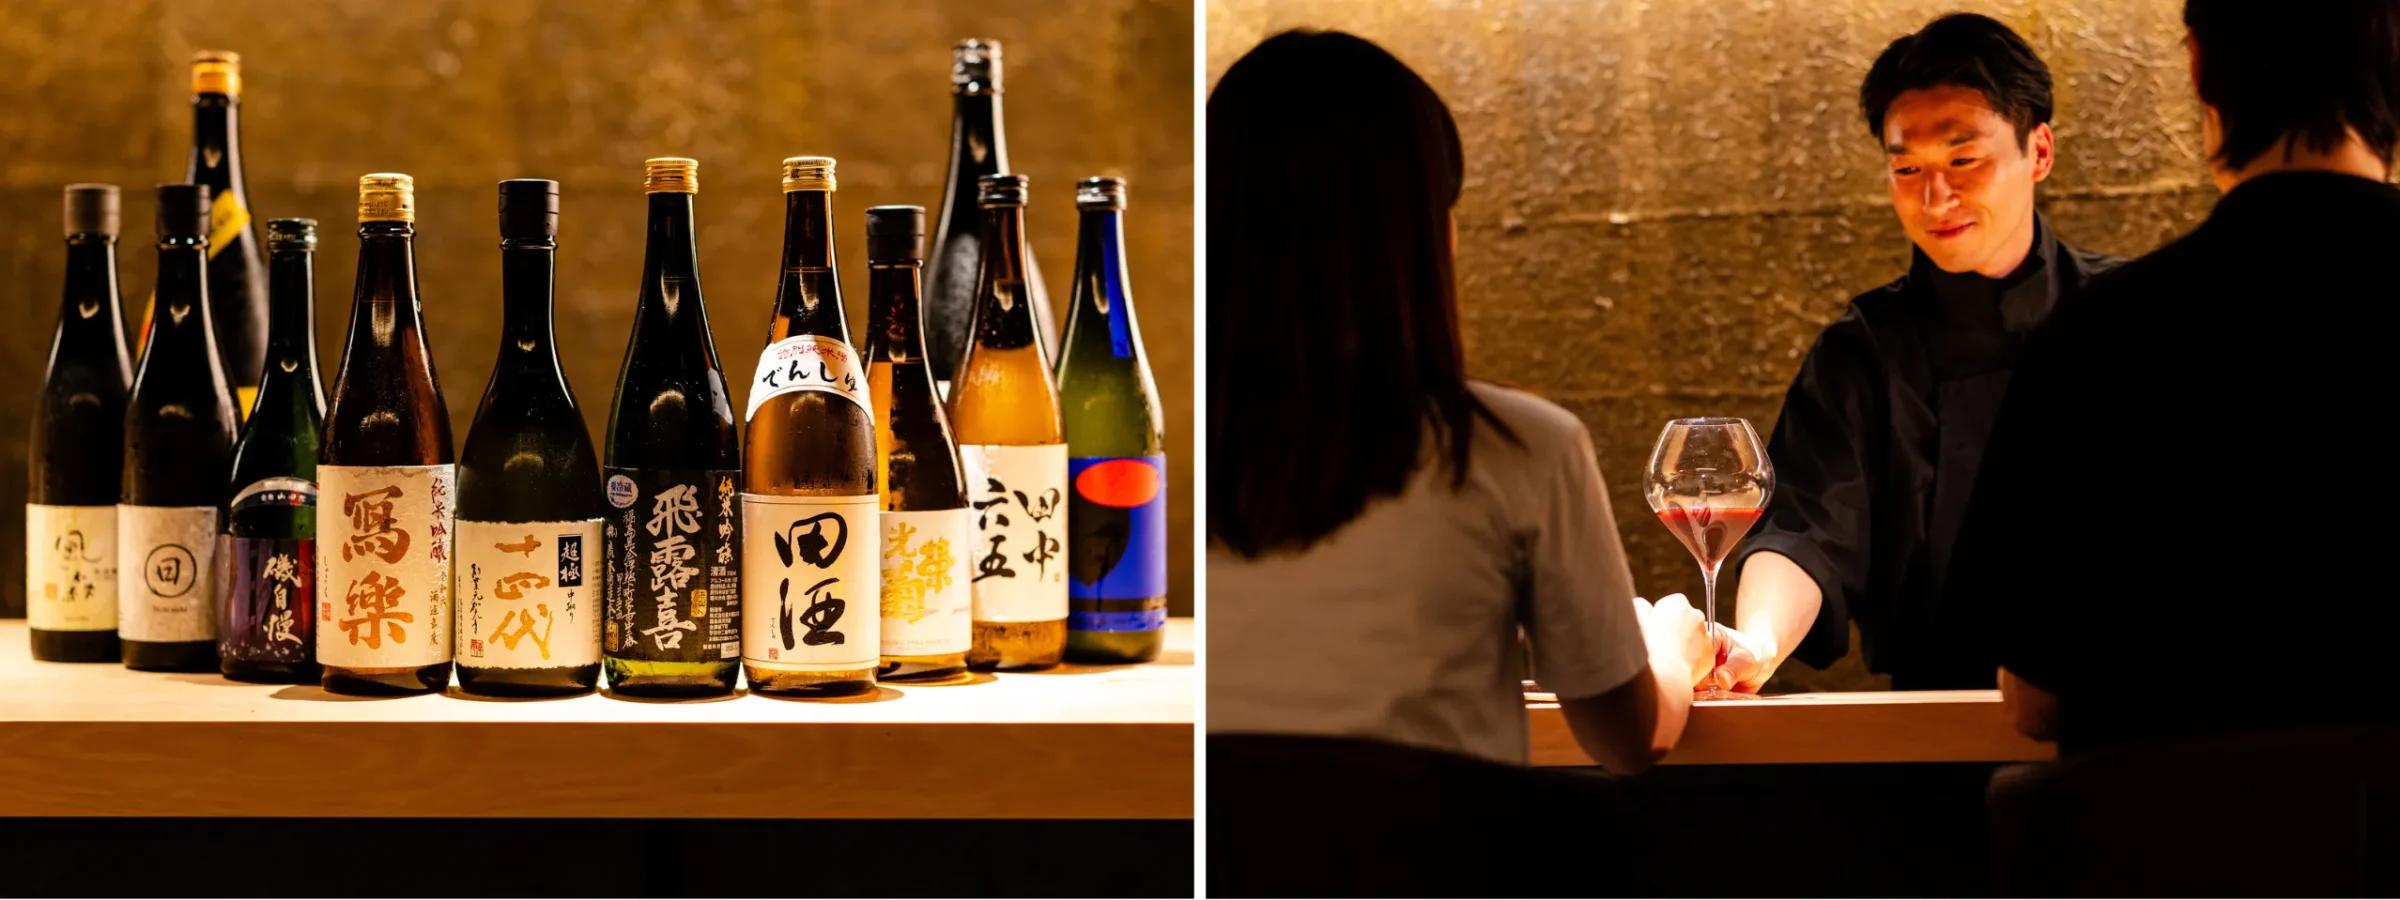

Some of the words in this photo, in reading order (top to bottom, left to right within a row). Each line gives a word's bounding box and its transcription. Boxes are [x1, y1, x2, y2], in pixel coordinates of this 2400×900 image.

[762, 359, 859, 392] でんしゅ
[777, 344, 848, 363] 特別純米酒
[640, 483, 702, 651] 飛露喜
[971, 477, 1016, 583] 六五
[1013, 488, 1061, 584] 田中
[262, 553, 303, 645] 磯自慢
[488, 533, 551, 661] 十四代
[565, 588, 576, 624] 中取り
[774, 511, 848, 651] 田酒
